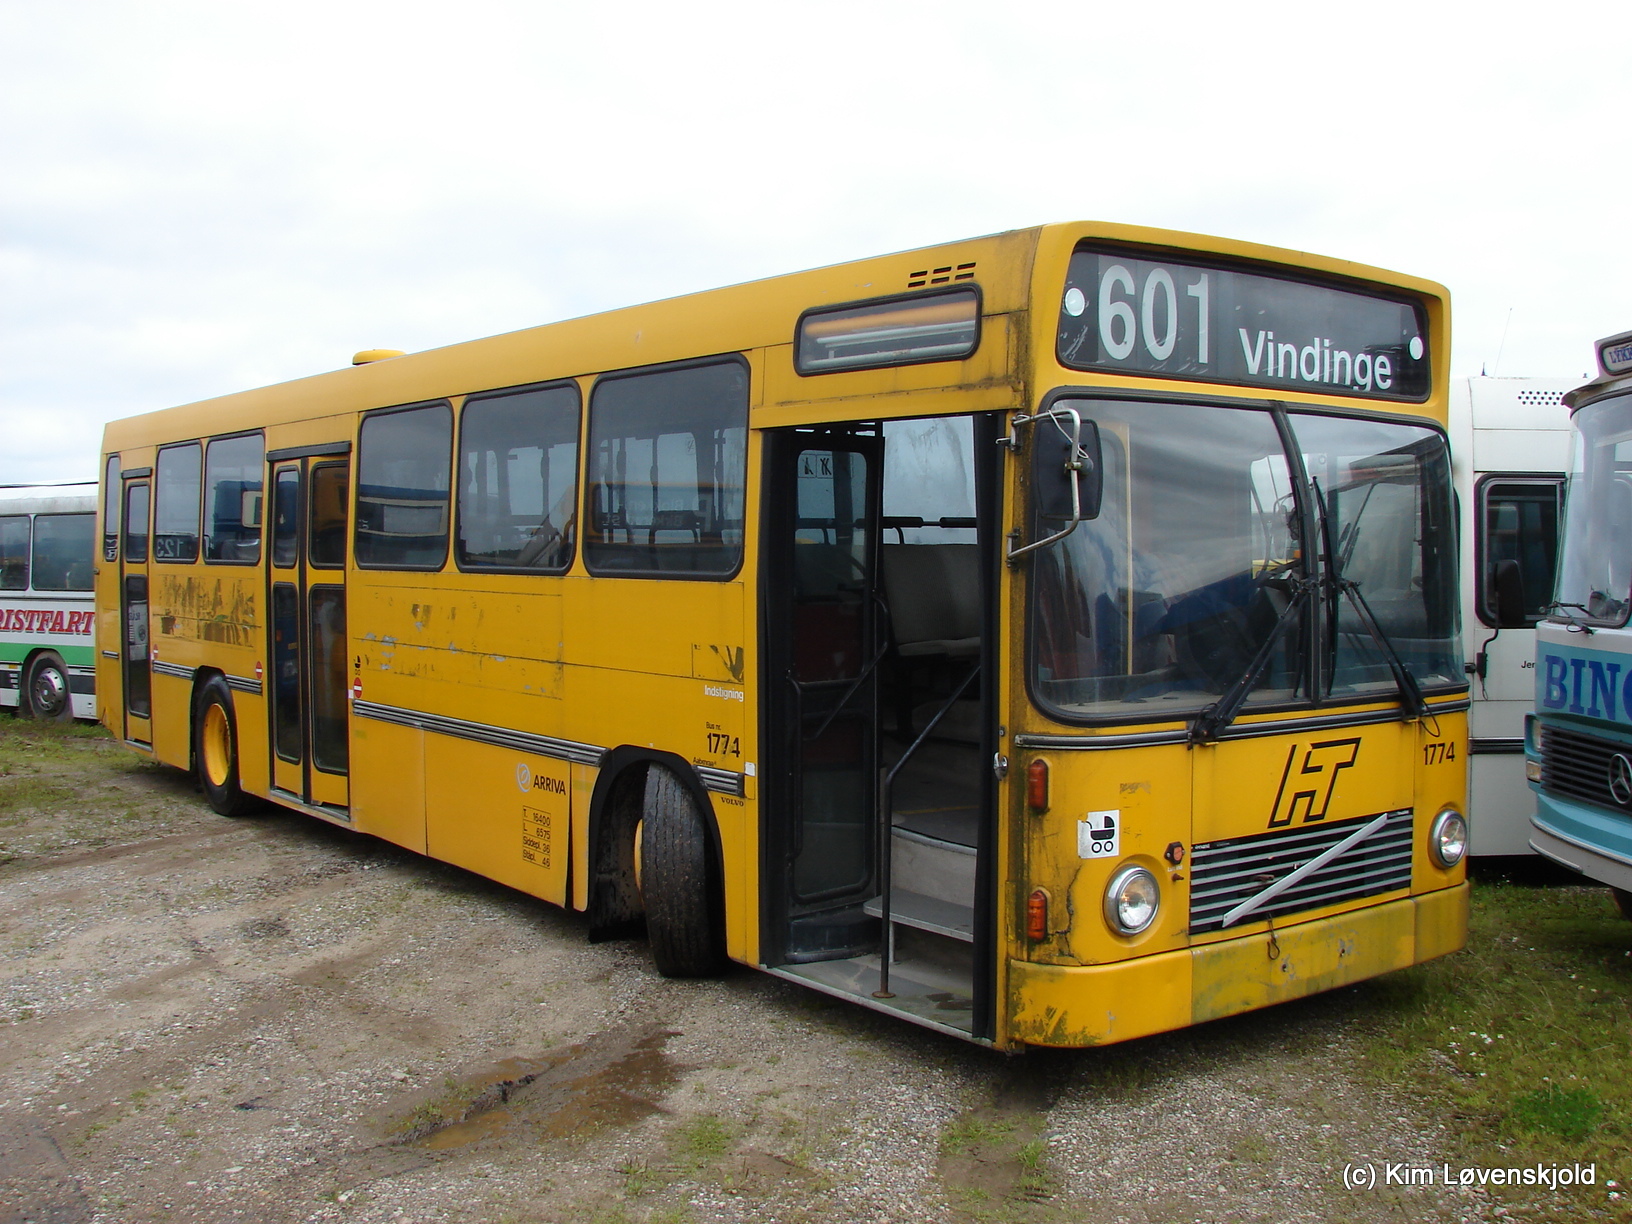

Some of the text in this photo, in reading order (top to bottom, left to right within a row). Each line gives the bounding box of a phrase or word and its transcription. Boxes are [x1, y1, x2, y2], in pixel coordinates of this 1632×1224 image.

[1099, 264, 1209, 364] 601
[1238, 327, 1393, 393] Vindinge
[704, 684, 744, 702] Indstigning
[707, 732, 741, 758] 1774
[1423, 741, 1455, 766] 1774
[533, 774, 567, 796] ARRIVA
[721, 796, 745, 807] VOLVO
